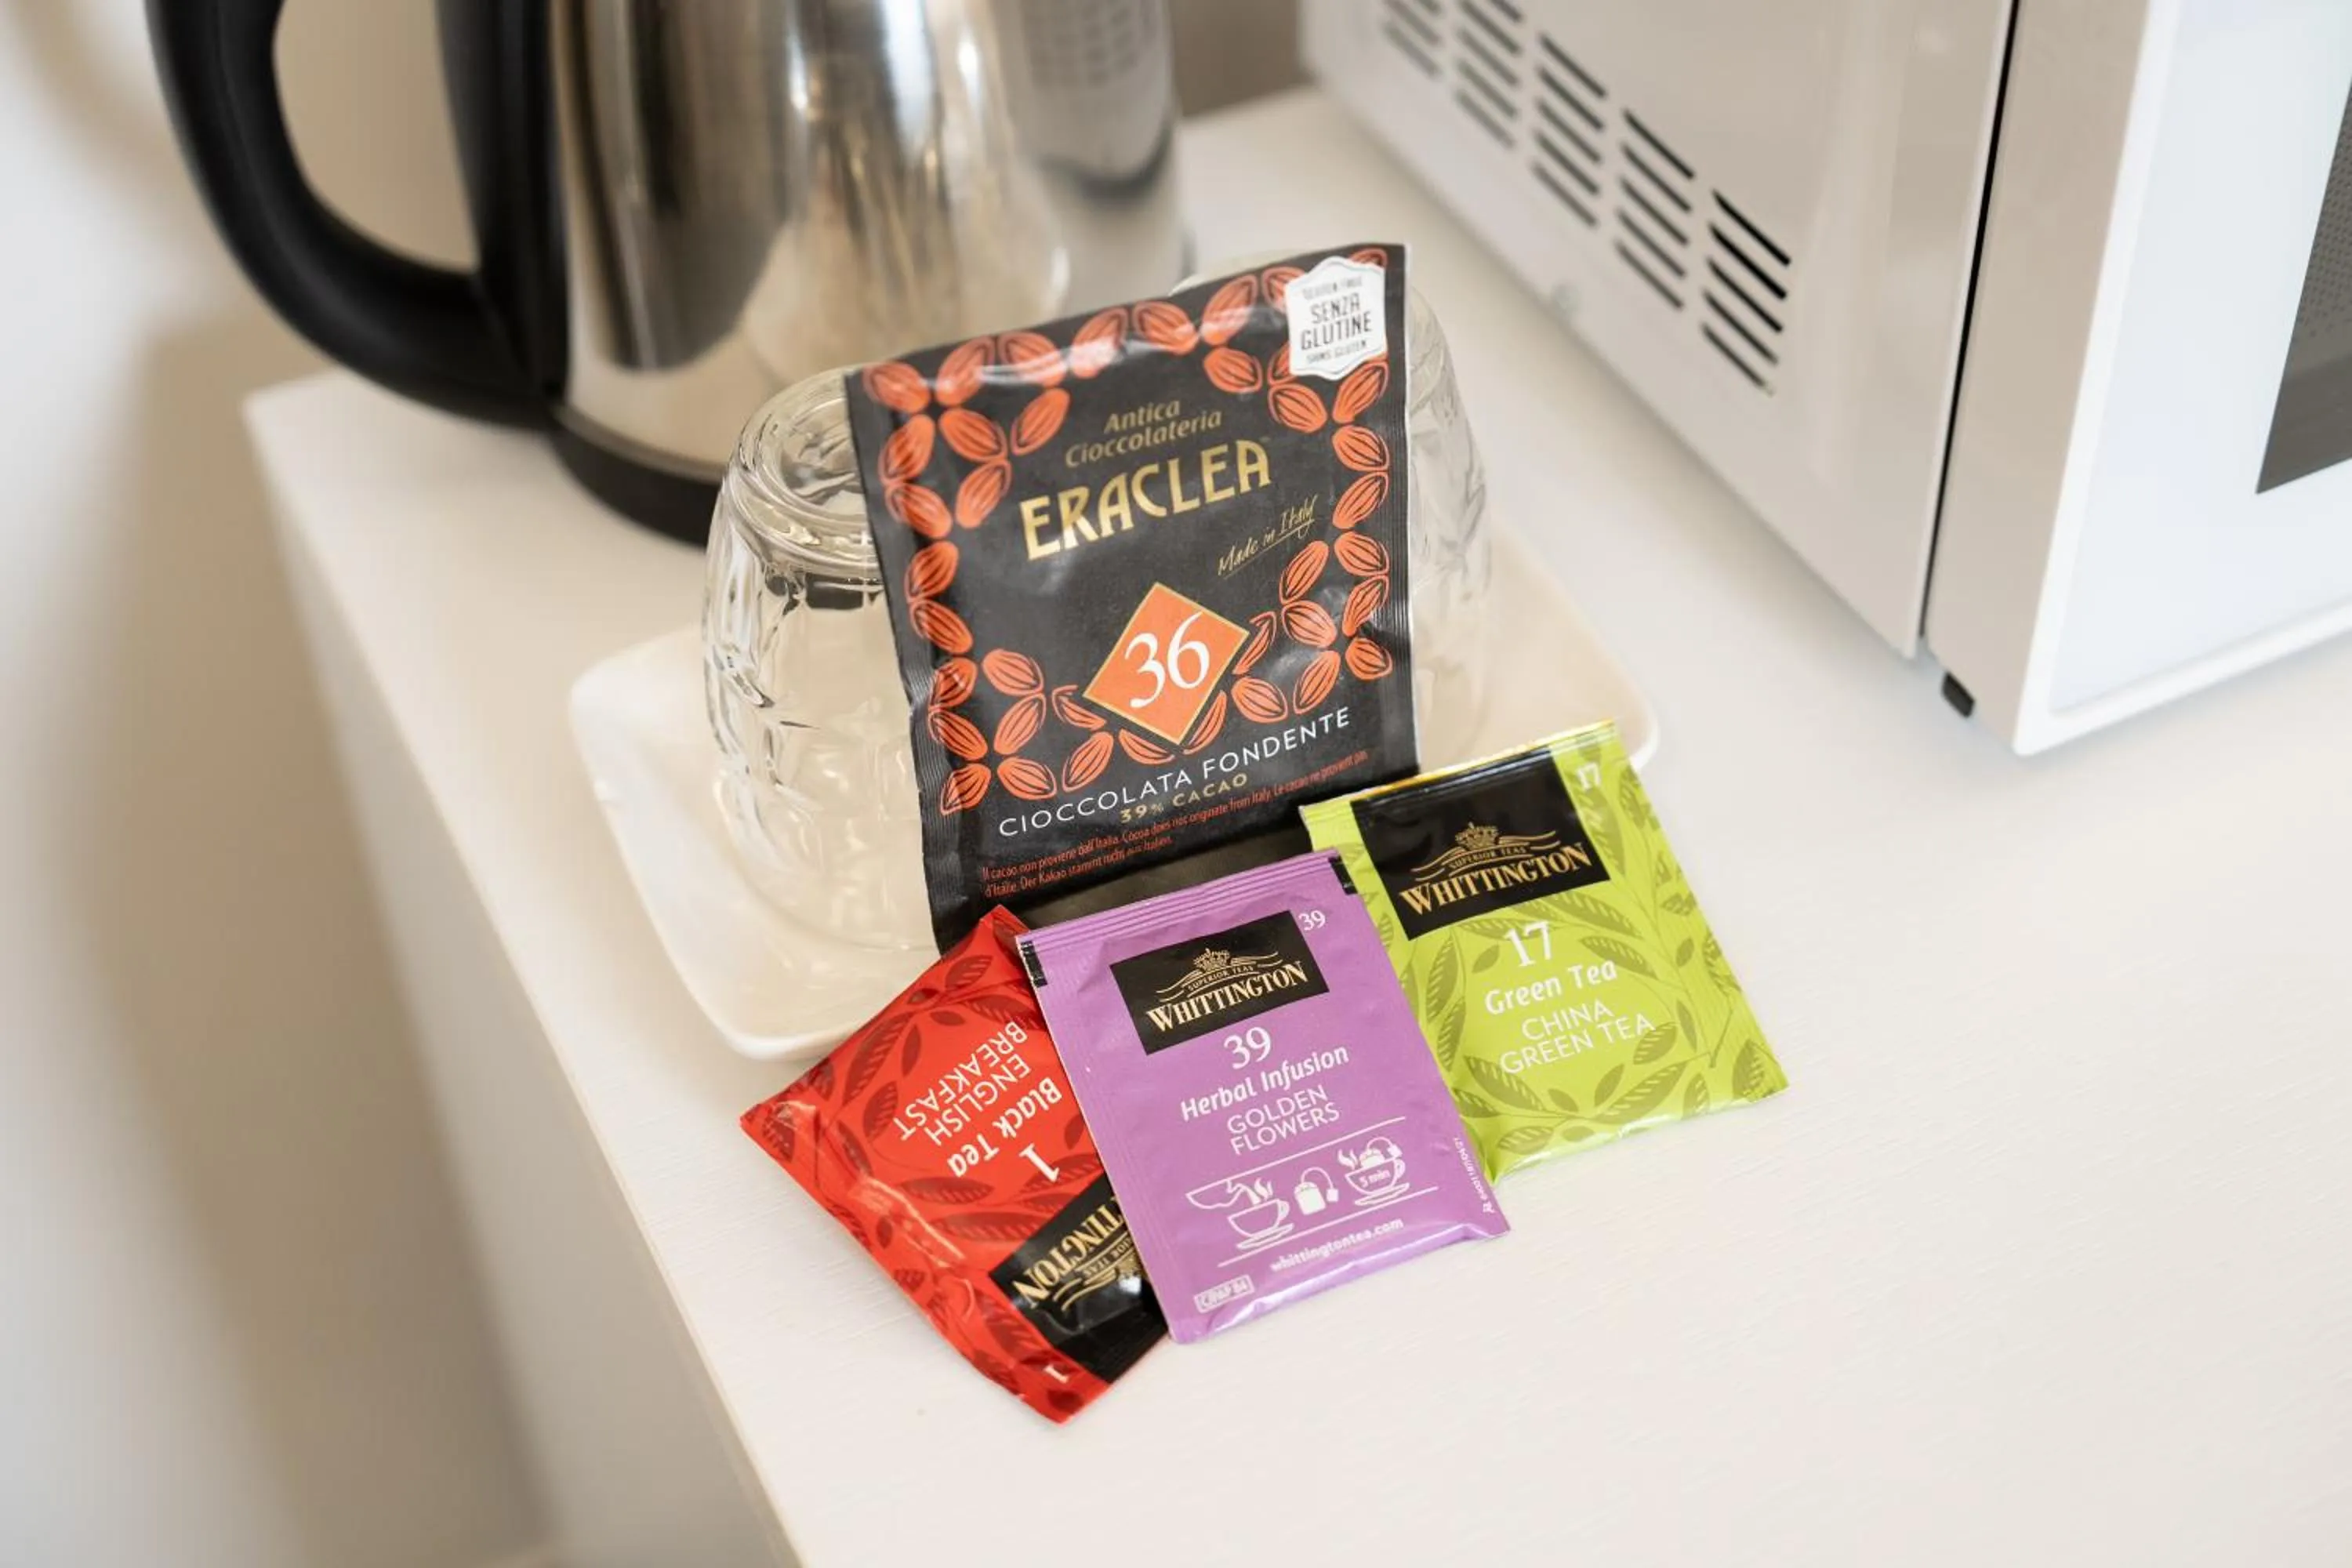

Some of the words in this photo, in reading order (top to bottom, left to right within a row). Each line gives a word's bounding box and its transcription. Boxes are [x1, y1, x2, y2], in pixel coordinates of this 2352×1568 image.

[1301, 310, 1372, 350] GLUTINE
[1311, 292, 1360, 324] SENZA
[1065, 411, 1222, 468] Cioccolateria
[1104, 401, 1180, 434] Antica
[1019, 439, 1272, 560] ERACLEA
[1218, 537, 1258, 576] Made
[1263, 527, 1276, 546] in
[1279, 494, 1319, 539] Italy
[1123, 612, 1210, 709] 36
[999, 769, 1192, 837] CIOCCOLATA
[1203, 706, 1350, 779] FONDENTE
[1577, 764, 1602, 790] 17
[1120, 803, 1163, 823] 39%
[1172, 773, 1247, 807] CACAO
[992, 866, 1017, 879] cacao
[1020, 862, 1037, 873] non
[1039, 848, 1076, 869] proviene
[1123, 827, 1149, 843] Cocoa
[1150, 819, 1171, 836] does
[1189, 804, 1229, 824] originate
[1230, 795, 1250, 812] from
[1448, 847, 1498, 870] SUPERIOR
[1501, 843, 1527, 857] TEAS
[1020, 876, 1037, 891] Der
[1039, 869, 1067, 884] Kakao
[1399, 843, 1592, 916] WHITTINGTON
[1299, 909, 1326, 931] 39
[1504, 921, 1552, 967] 17
[1145, 960, 1309, 1034] WHITTINGTON
[1187, 969, 1229, 993] SUPERIOR
[1231, 964, 1254, 978] TEAS
[1484, 971, 1563, 1014] Green
[1568, 958, 1617, 989] Tea
[1499, 1028, 1593, 1076] GREEN
[1602, 1015, 1657, 1044] TEA
[1520, 998, 1615, 1043] CHINA
[1223, 1025, 1272, 1070] 39
[893, 1021, 1027, 1142] BREAKFAST
[924, 1054, 1031, 1146] ENGLISH
[993, 1076, 1062, 1138] Black
[1180, 1076, 1257, 1122] Herbal
[1261, 1045, 1349, 1093] Infusion
[1227, 1084, 1328, 1136] GOLDEN
[1229, 1103, 1340, 1156] FLOWERS
[948, 1133, 1000, 1178] Tea
[1019, 1142, 1059, 1183] 1
[1369, 1169, 1391, 1185] min
[1012, 1196, 1124, 1308] TINGTON
[1271, 1218, 1403, 1272] whittingtontea.com
[1044, 1364, 1069, 1383] 1
